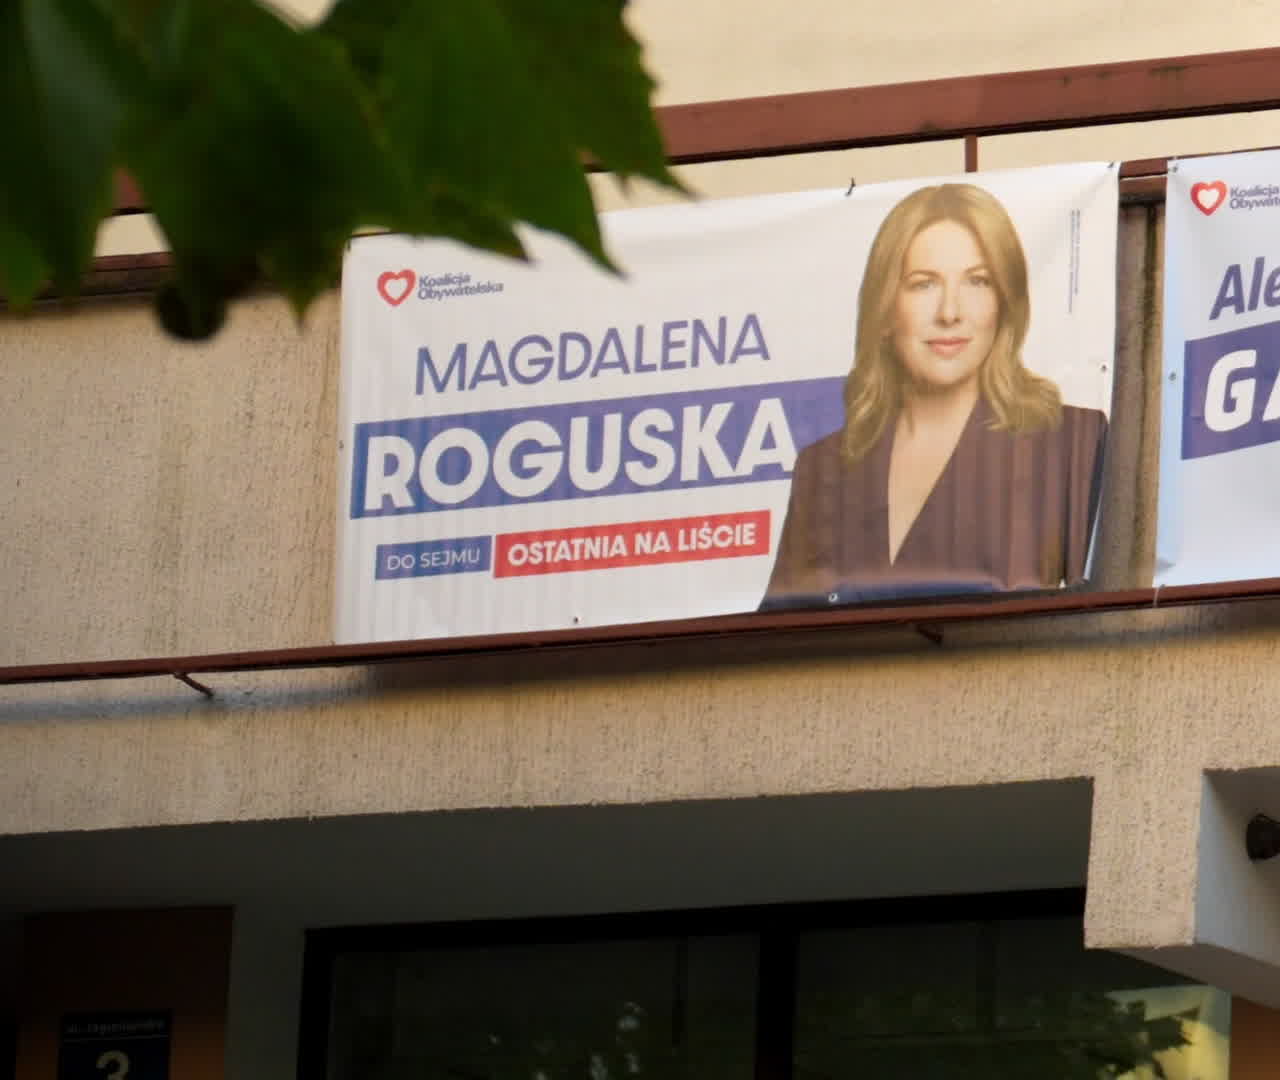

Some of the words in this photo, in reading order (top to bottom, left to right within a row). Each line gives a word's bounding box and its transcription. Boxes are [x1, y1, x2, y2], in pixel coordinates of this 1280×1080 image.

[1230, 184, 1280, 198] Koalicja
[417, 281, 504, 301] Obywatelska
[419, 272, 471, 287] Koalicja
[415, 313, 771, 395] MAGDALENA
[363, 397, 798, 512] ROGUSKA
[507, 533, 627, 566] OSTATNIA
[634, 529, 671, 555] NA
[678, 521, 757, 552] LIŚCIE
[386, 554, 415, 571] DO
[419, 548, 481, 568] SEJMU
